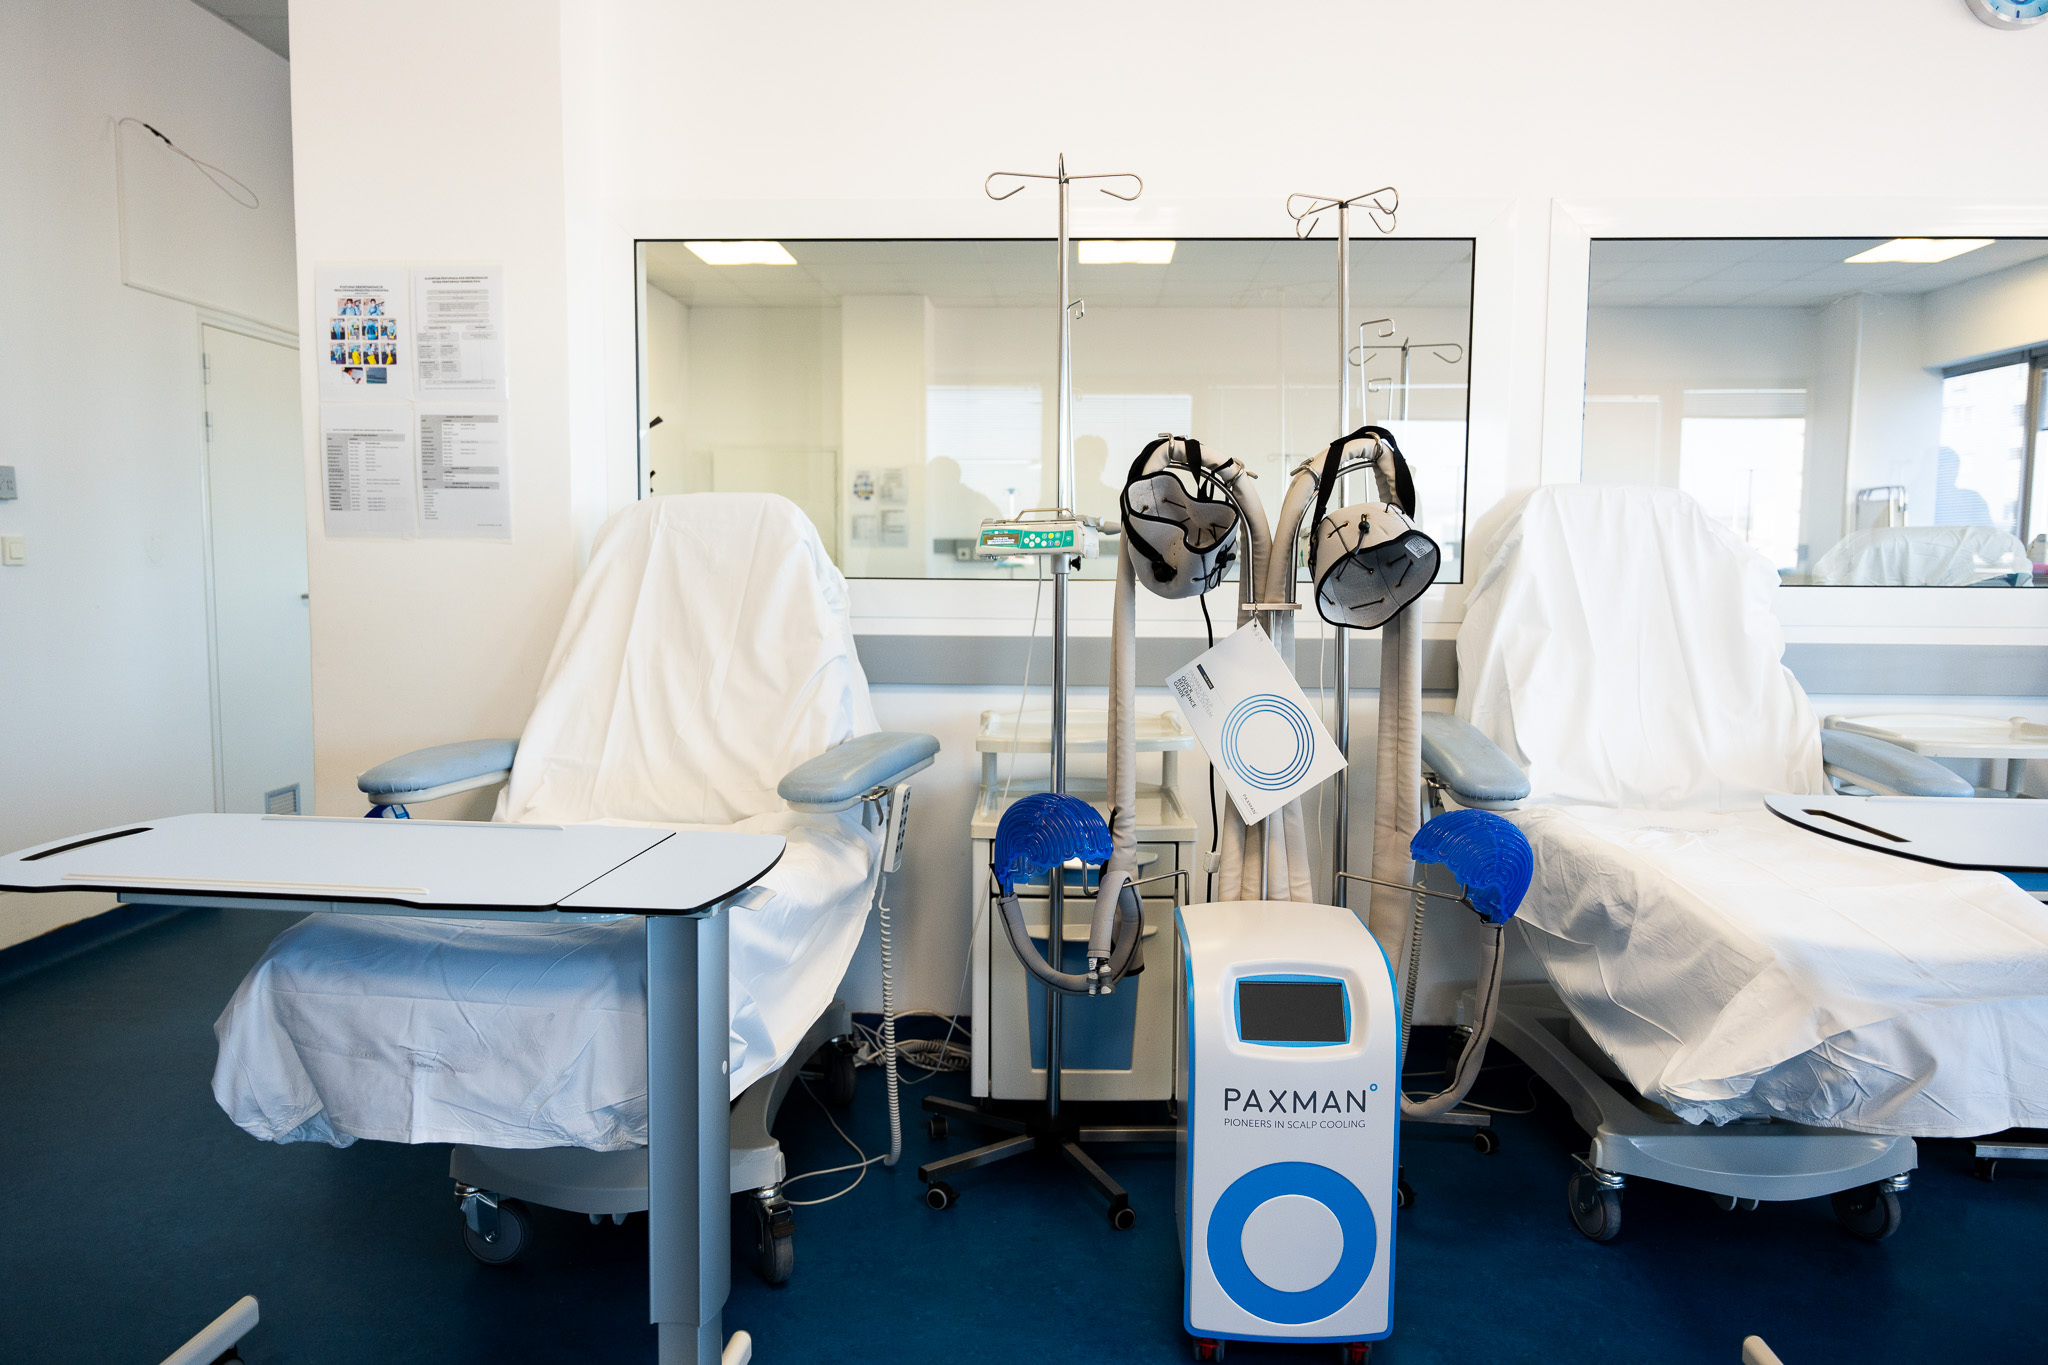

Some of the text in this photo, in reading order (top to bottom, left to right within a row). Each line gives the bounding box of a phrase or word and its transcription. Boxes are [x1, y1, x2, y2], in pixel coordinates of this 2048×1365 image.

[1173, 681, 1186, 698] GUIDE
[1177, 678, 1198, 709] REFERENCE
[1181, 675, 1194, 694] QUICK
[1224, 1087, 1367, 1114] PAXMAN
[1224, 1117, 1366, 1130] PIONEERS IN SCALP COOLING
